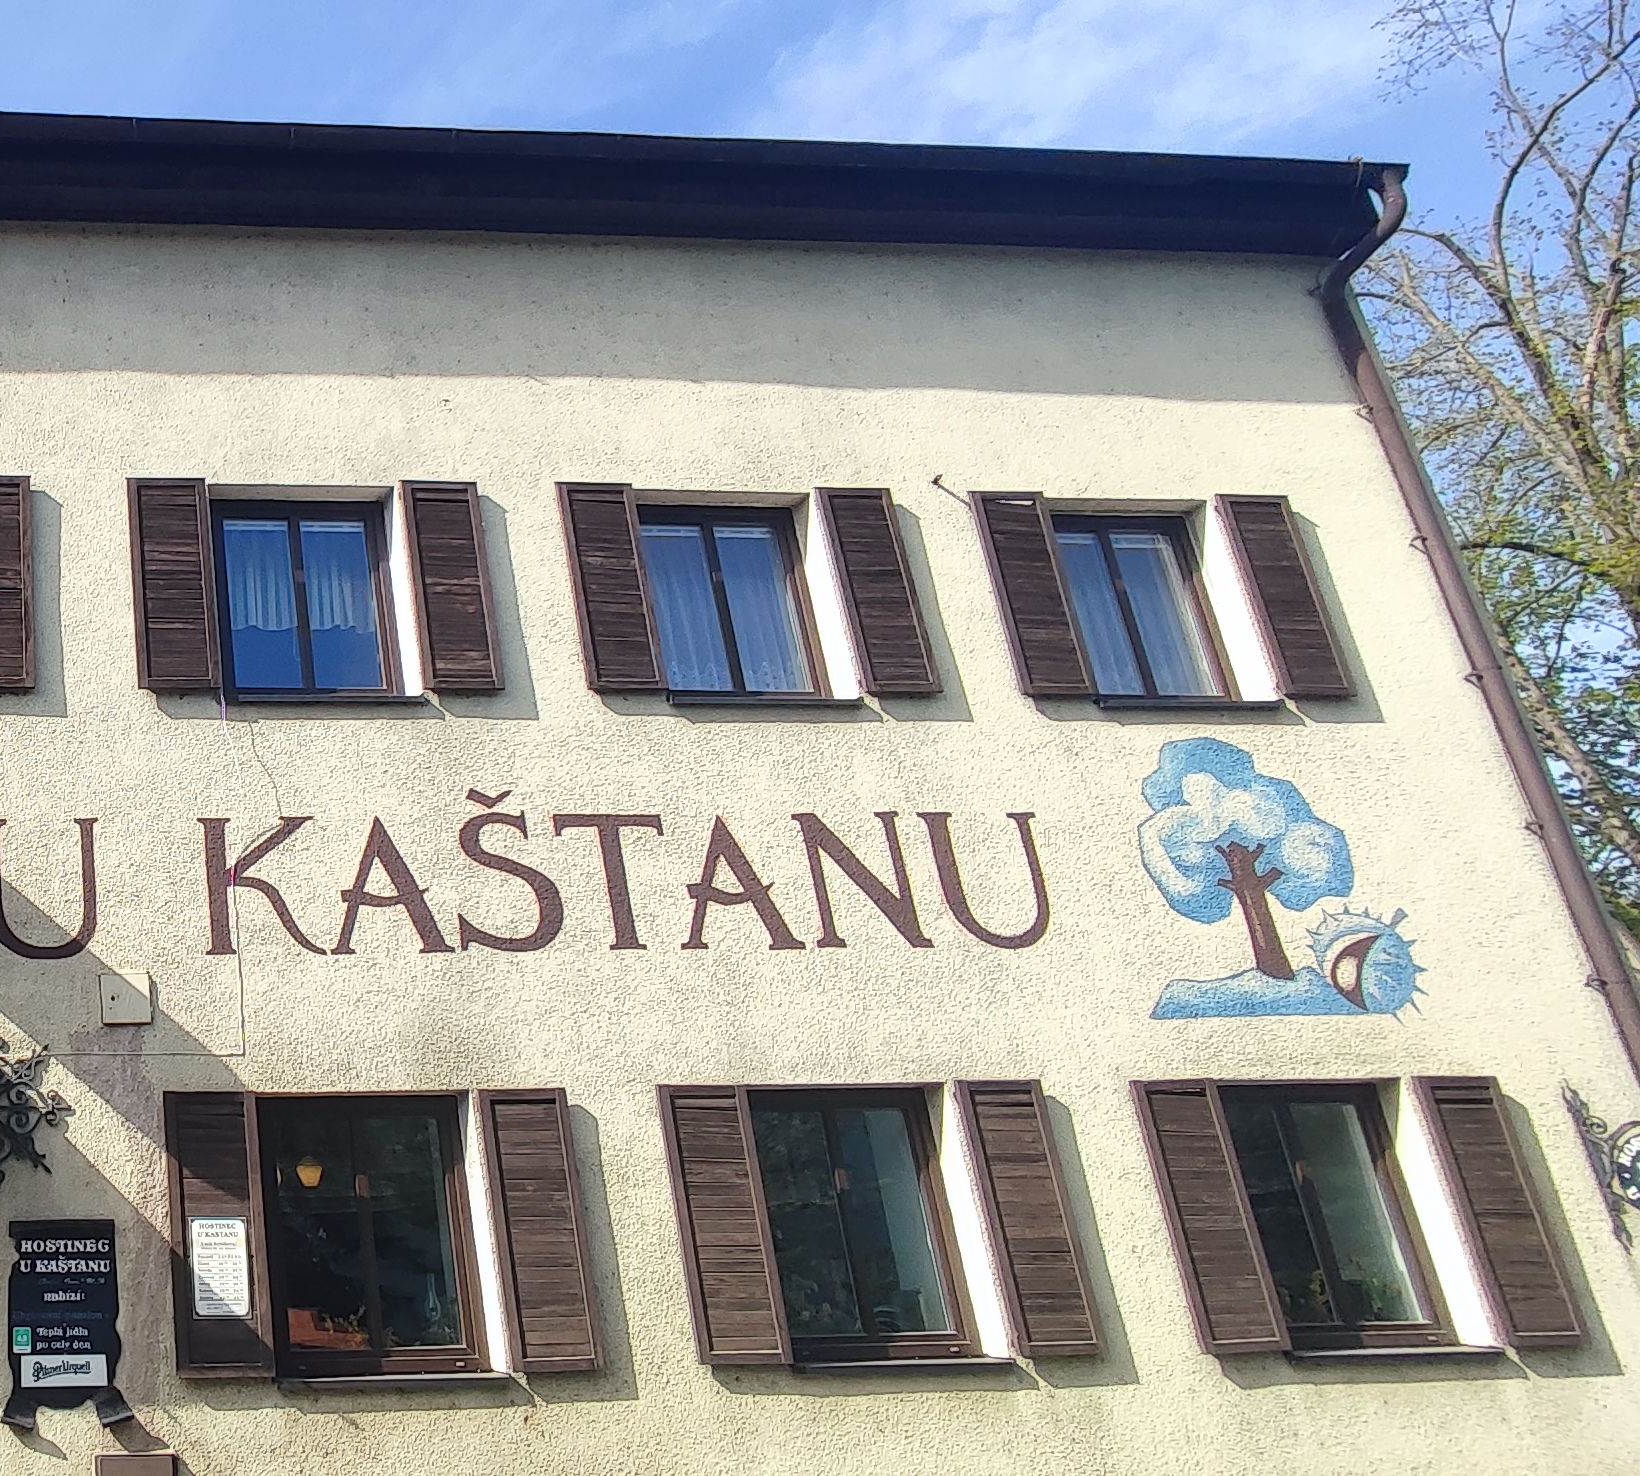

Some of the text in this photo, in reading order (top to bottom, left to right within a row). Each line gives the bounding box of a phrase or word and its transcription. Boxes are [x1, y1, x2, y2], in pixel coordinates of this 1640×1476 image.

[196, 788, 1050, 955] KAŠTANU
[20, 1239, 110, 1253] HOSTINEC
[20, 1255, 111, 1273] U KAŠTANU
[32, 1360, 91, 1382] Pilsner Urquell
